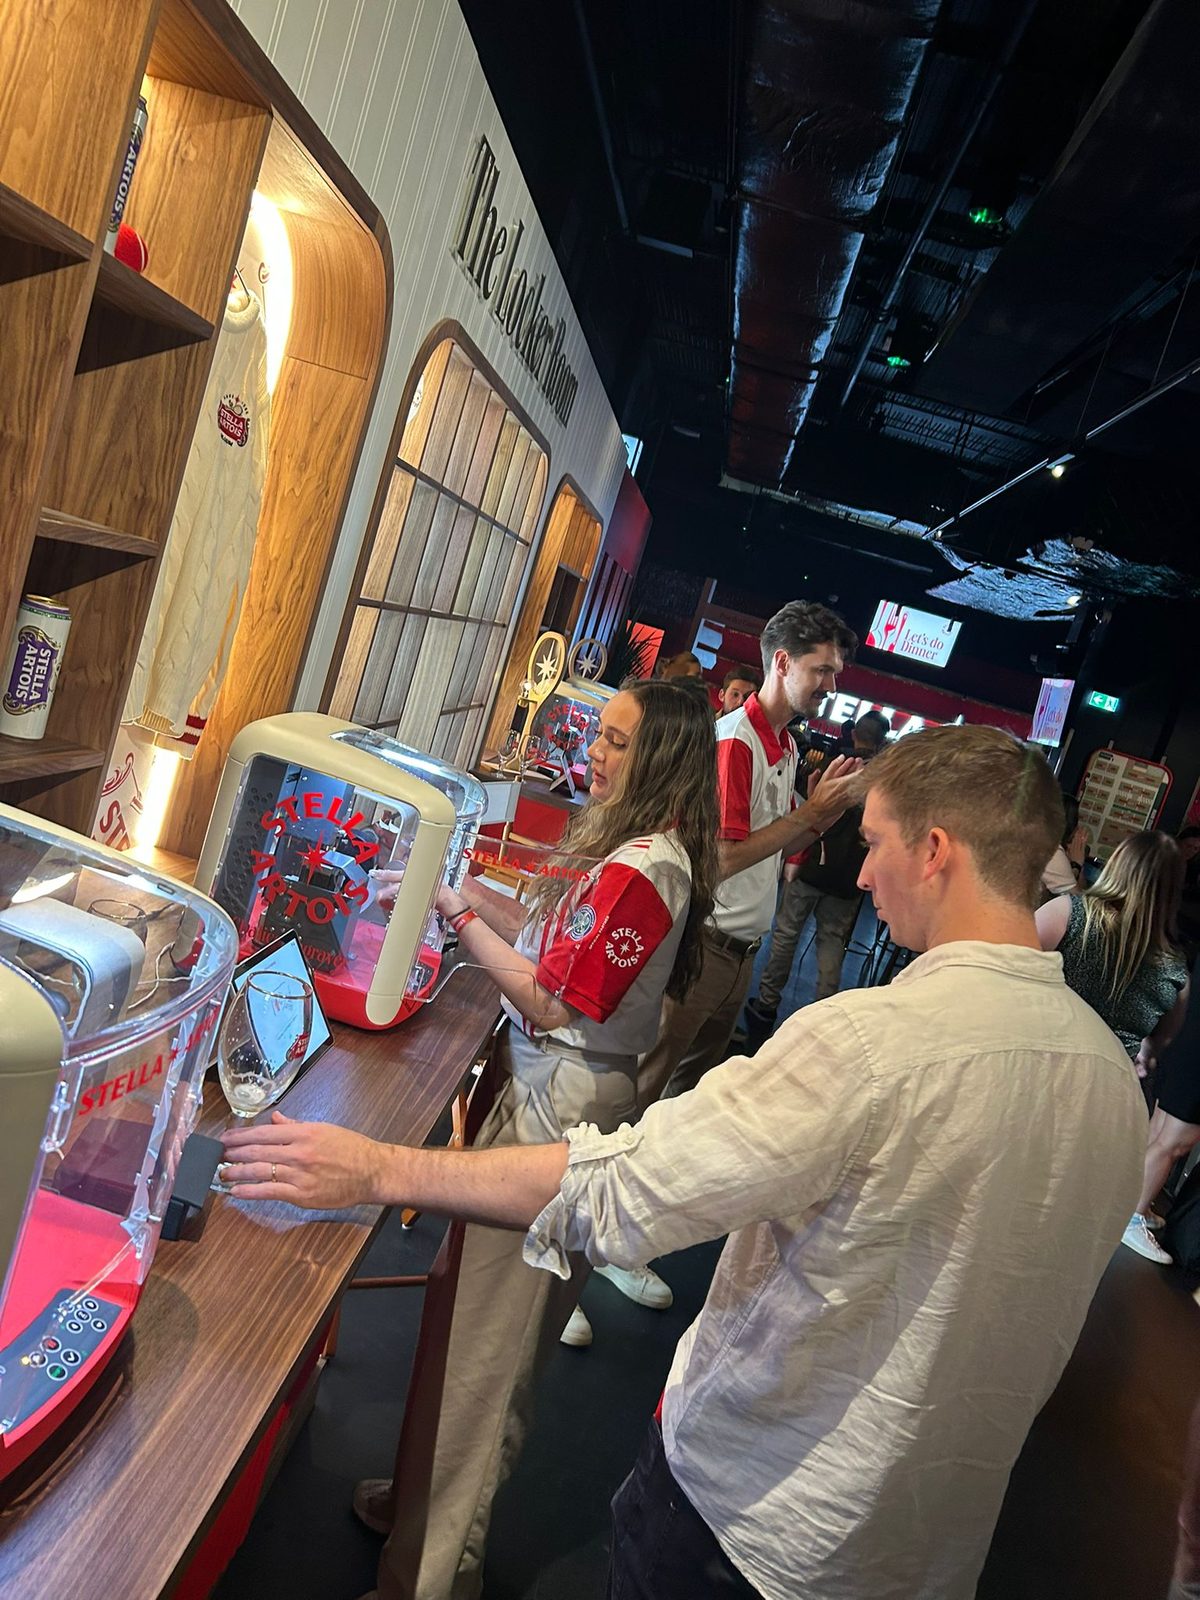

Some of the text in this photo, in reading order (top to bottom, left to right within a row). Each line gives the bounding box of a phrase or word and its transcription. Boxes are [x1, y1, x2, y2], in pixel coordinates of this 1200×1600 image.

[114, 144, 138, 214] ARTOIS
[454, 134, 578, 428] The Locker Room
[900, 640, 938, 661] Dinner
[904, 629, 929, 647] Let's
[930, 637, 944, 651] do
[15, 643, 38, 701] ARTOIS
[29, 647, 52, 701] STELLA
[260, 791, 381, 865] STELLA
[251, 849, 370, 925] ARTOIS
[462, 847, 592, 882] STELLA ARTOIS
[605, 940, 640, 968] ARTOIS
[611, 927, 645, 953] STELLA
[78, 1054, 164, 1117] STELLA
